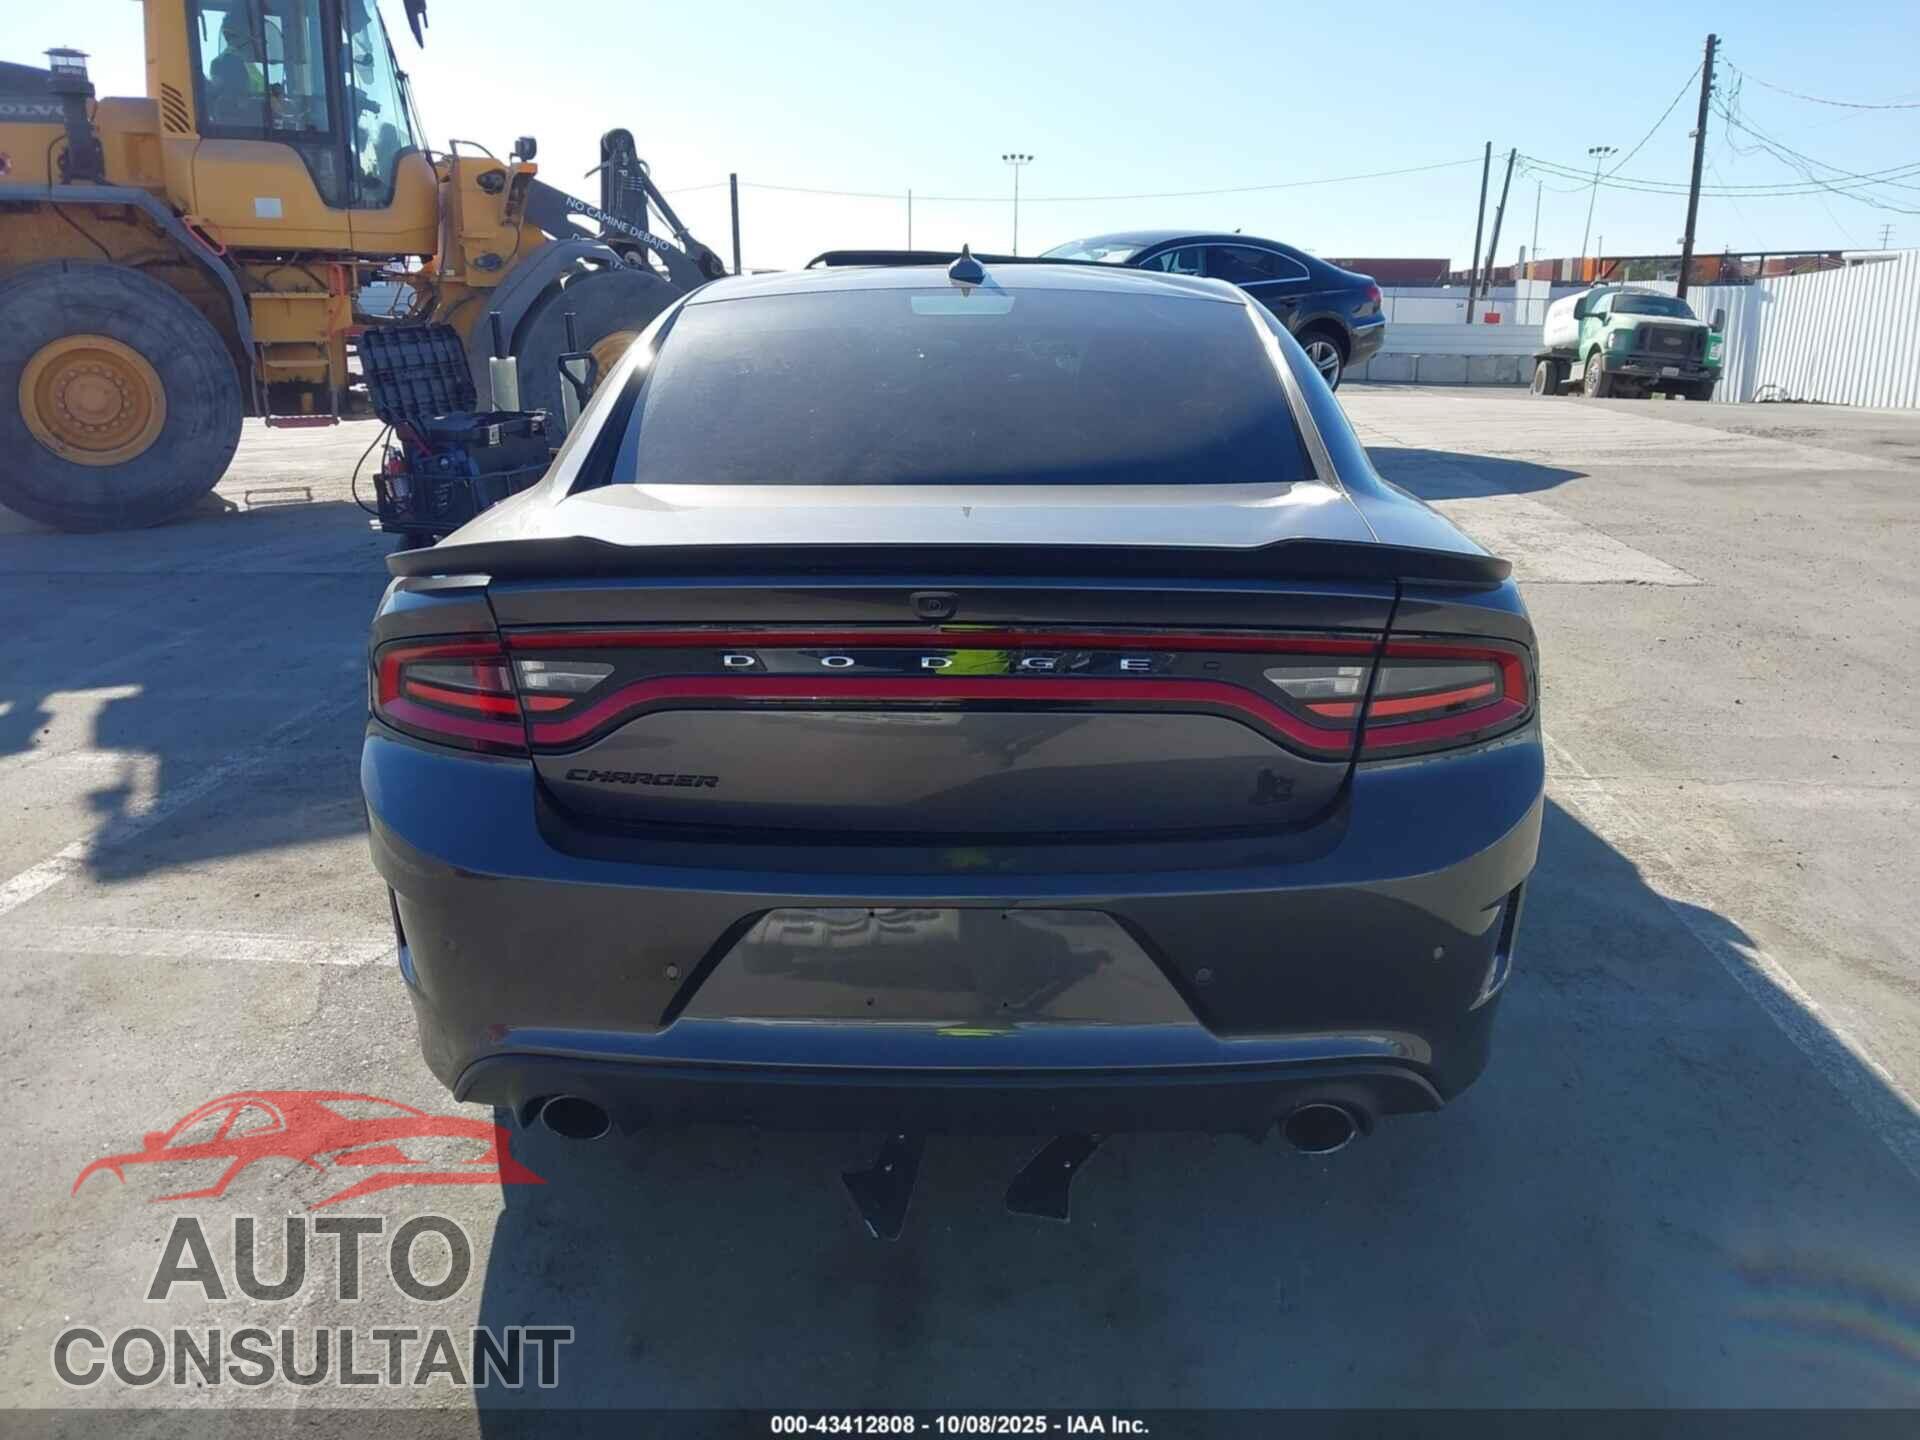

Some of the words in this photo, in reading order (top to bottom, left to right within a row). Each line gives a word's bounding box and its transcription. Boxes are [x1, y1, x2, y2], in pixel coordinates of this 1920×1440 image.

[0, 104, 65, 116] OLV
[566, 197, 585, 211] NO
[586, 206, 630, 233] CAMINE
[630, 226, 670, 251] DEBAJO
[723, 655, 1151, 671] DODGE
[565, 768, 719, 788] CHARGER
